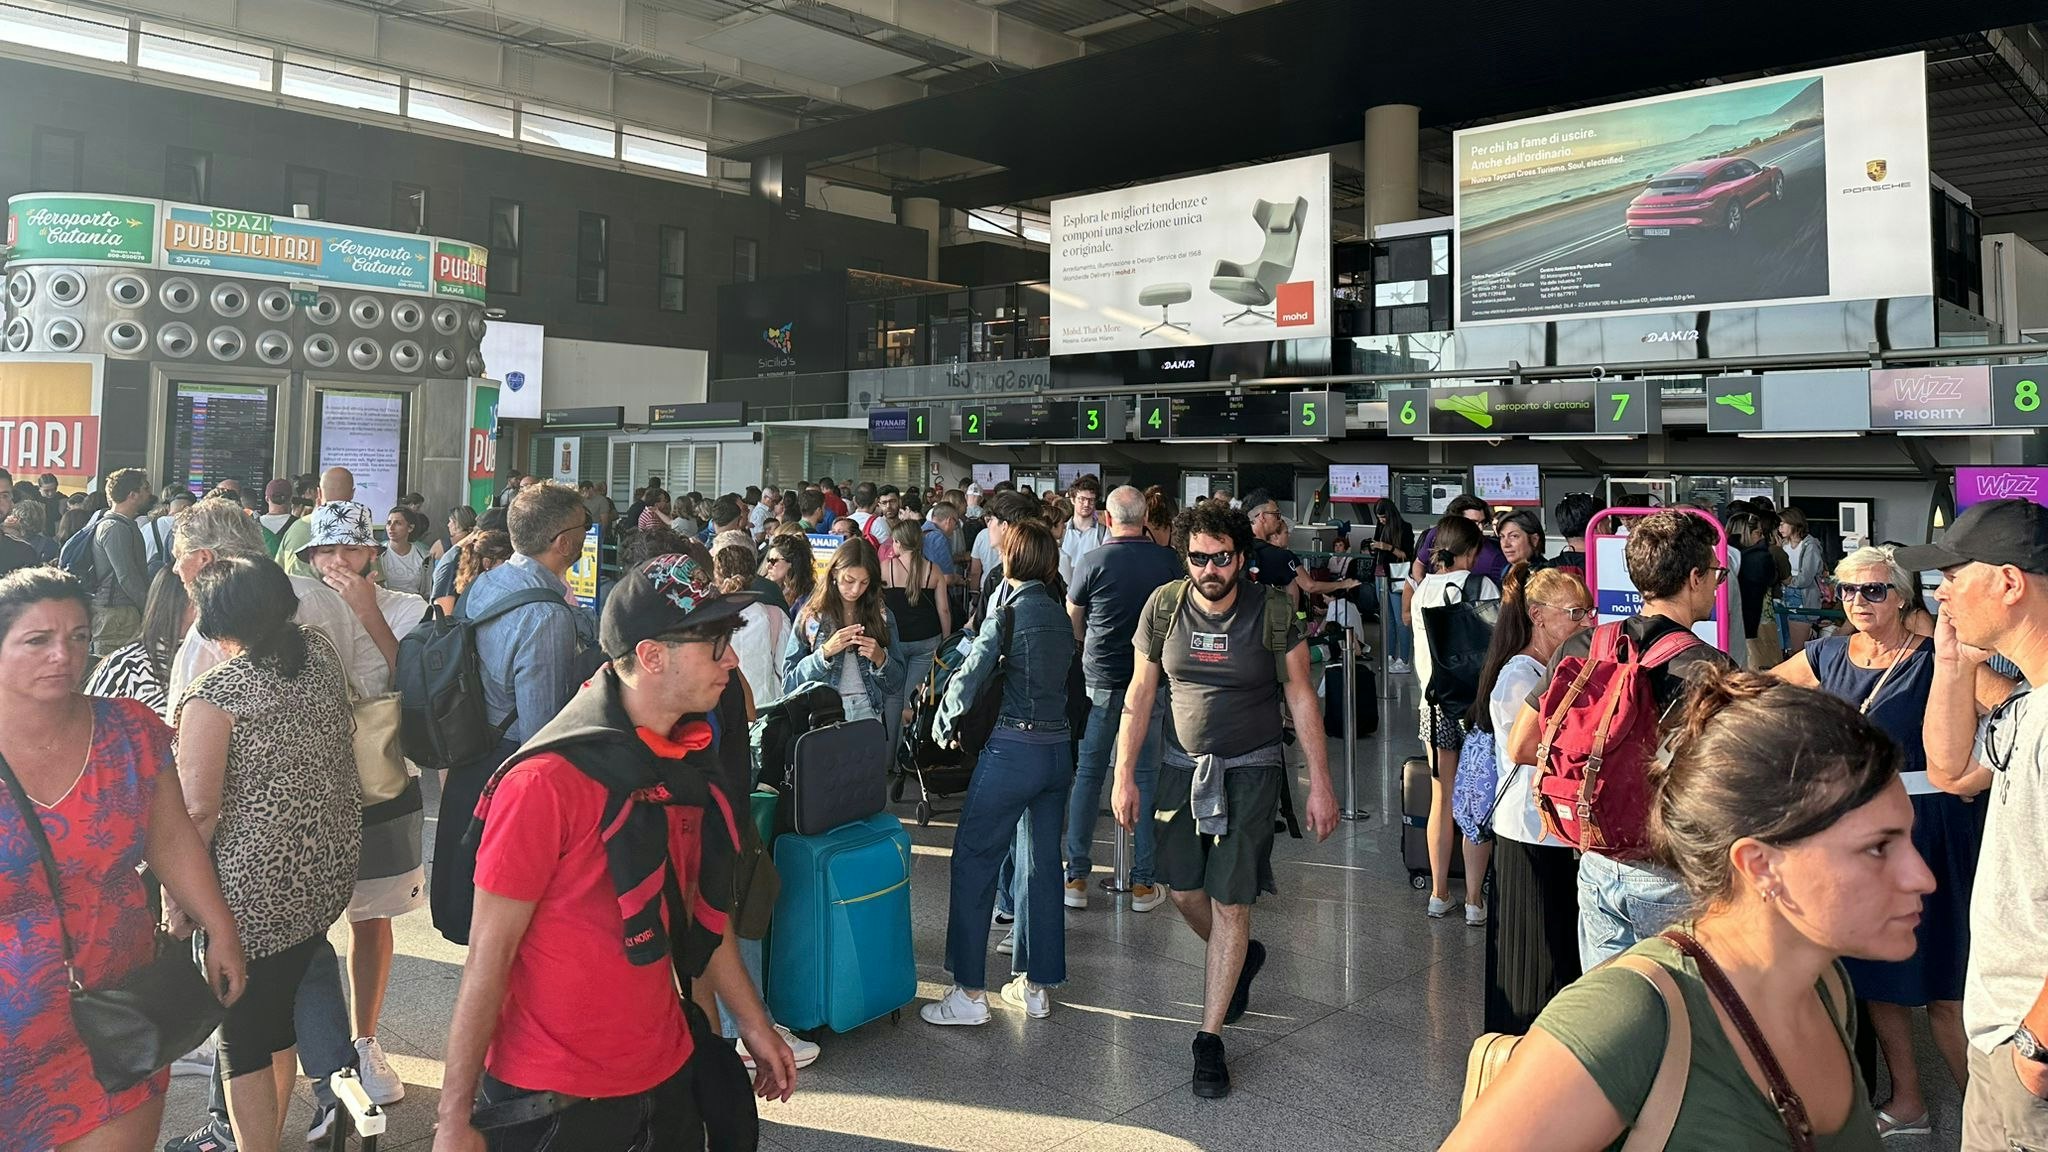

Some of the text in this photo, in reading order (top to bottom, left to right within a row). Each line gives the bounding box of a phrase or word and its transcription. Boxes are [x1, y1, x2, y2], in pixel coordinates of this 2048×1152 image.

[1471, 128, 1597, 156] Per chi ha fame di uscire.
[1471, 148, 1574, 171] Anche dall'ordinario.
[1471, 176, 1492, 185] Nuova
[1493, 172, 1516, 183] Taycan
[1517, 169, 1536, 178] Cross
[1586, 155, 1625, 168] electrified.
[1843, 181, 1911, 194] PORSCHE
[27, 208, 122, 230] Aeroporto
[216, 213, 267, 231] SPAZI
[1063, 196, 1208, 228] Esplora le migliori tendenze e
[47, 227, 123, 246] Catania
[1062, 213, 1202, 242] componi una selezione unica
[173, 224, 316, 261] PUBBLICITARI
[328, 239, 412, 261] Aeroporto
[1062, 241, 1114, 257] e originale.
[352, 257, 413, 277] Catania
[1137, 256, 1155, 264] Design
[1157, 254, 1177, 262] Service
[1283, 312, 1308, 321] mohd
[1647, 330, 1699, 343] DAMIR
[1164, 360, 1195, 370] DAMIR
[1495, 399, 1590, 413] aeroporto di catania
[2014, 380, 2041, 412] 8
[1302, 402, 1316, 426] 5
[1400, 400, 1417, 425] 6
[1610, 394, 1630, 422] 7
[1894, 409, 1965, 420] PRIORITY
[875, 419, 906, 427] RYANAIR
[916, 415, 923, 435] 1
[968, 414, 979, 434] 2
[1087, 410, 1099, 431] 3
[1147, 407, 1162, 430] 4
[1612, 605, 1631, 613] non
